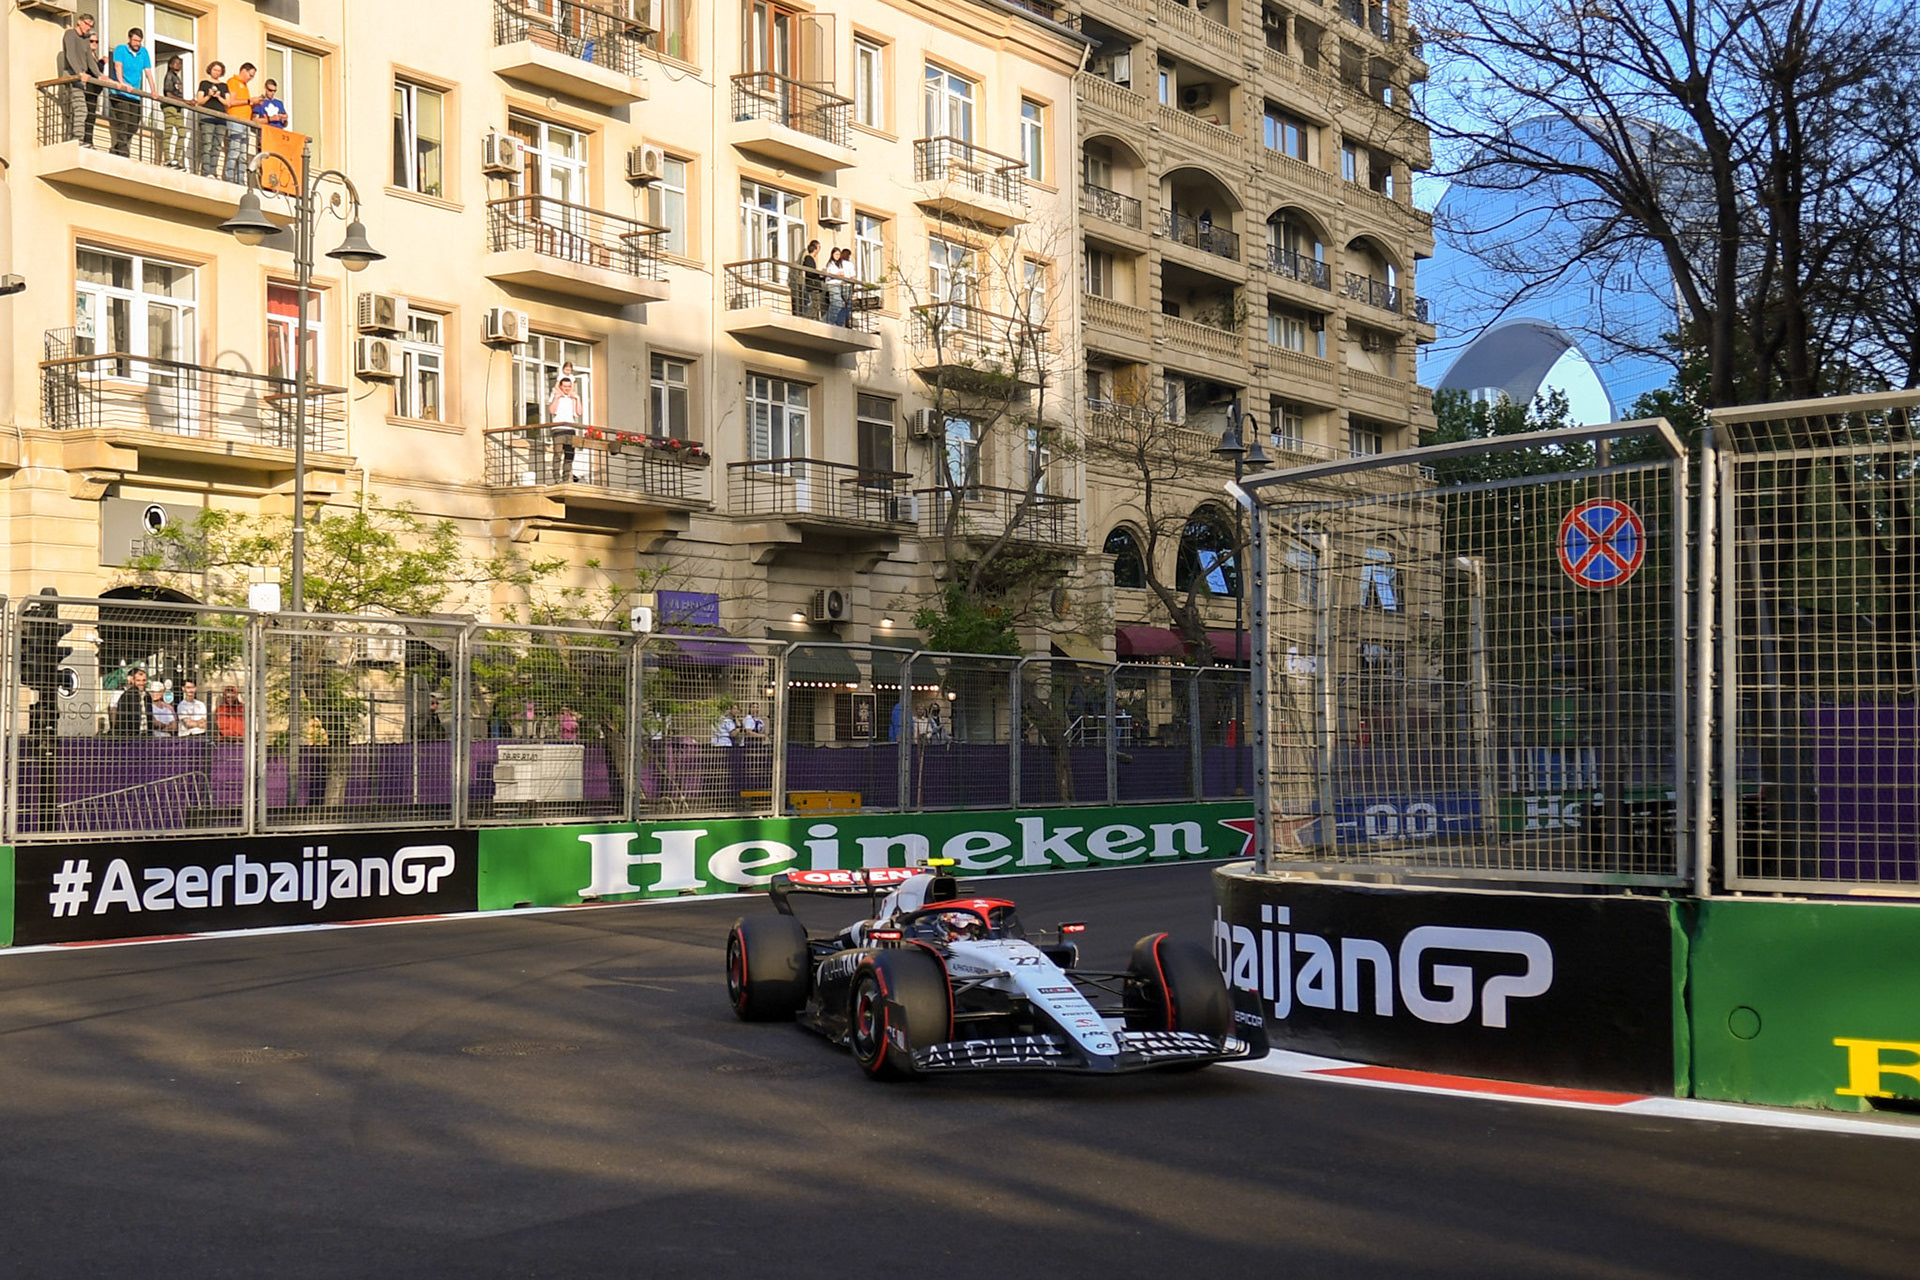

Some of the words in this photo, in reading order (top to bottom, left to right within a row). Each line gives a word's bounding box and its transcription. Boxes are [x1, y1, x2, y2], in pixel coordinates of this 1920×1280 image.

[49, 844, 456, 918] #AzerbaijanGP
[577, 816, 1210, 899] Heineken
[1009, 956, 1046, 966] 22
